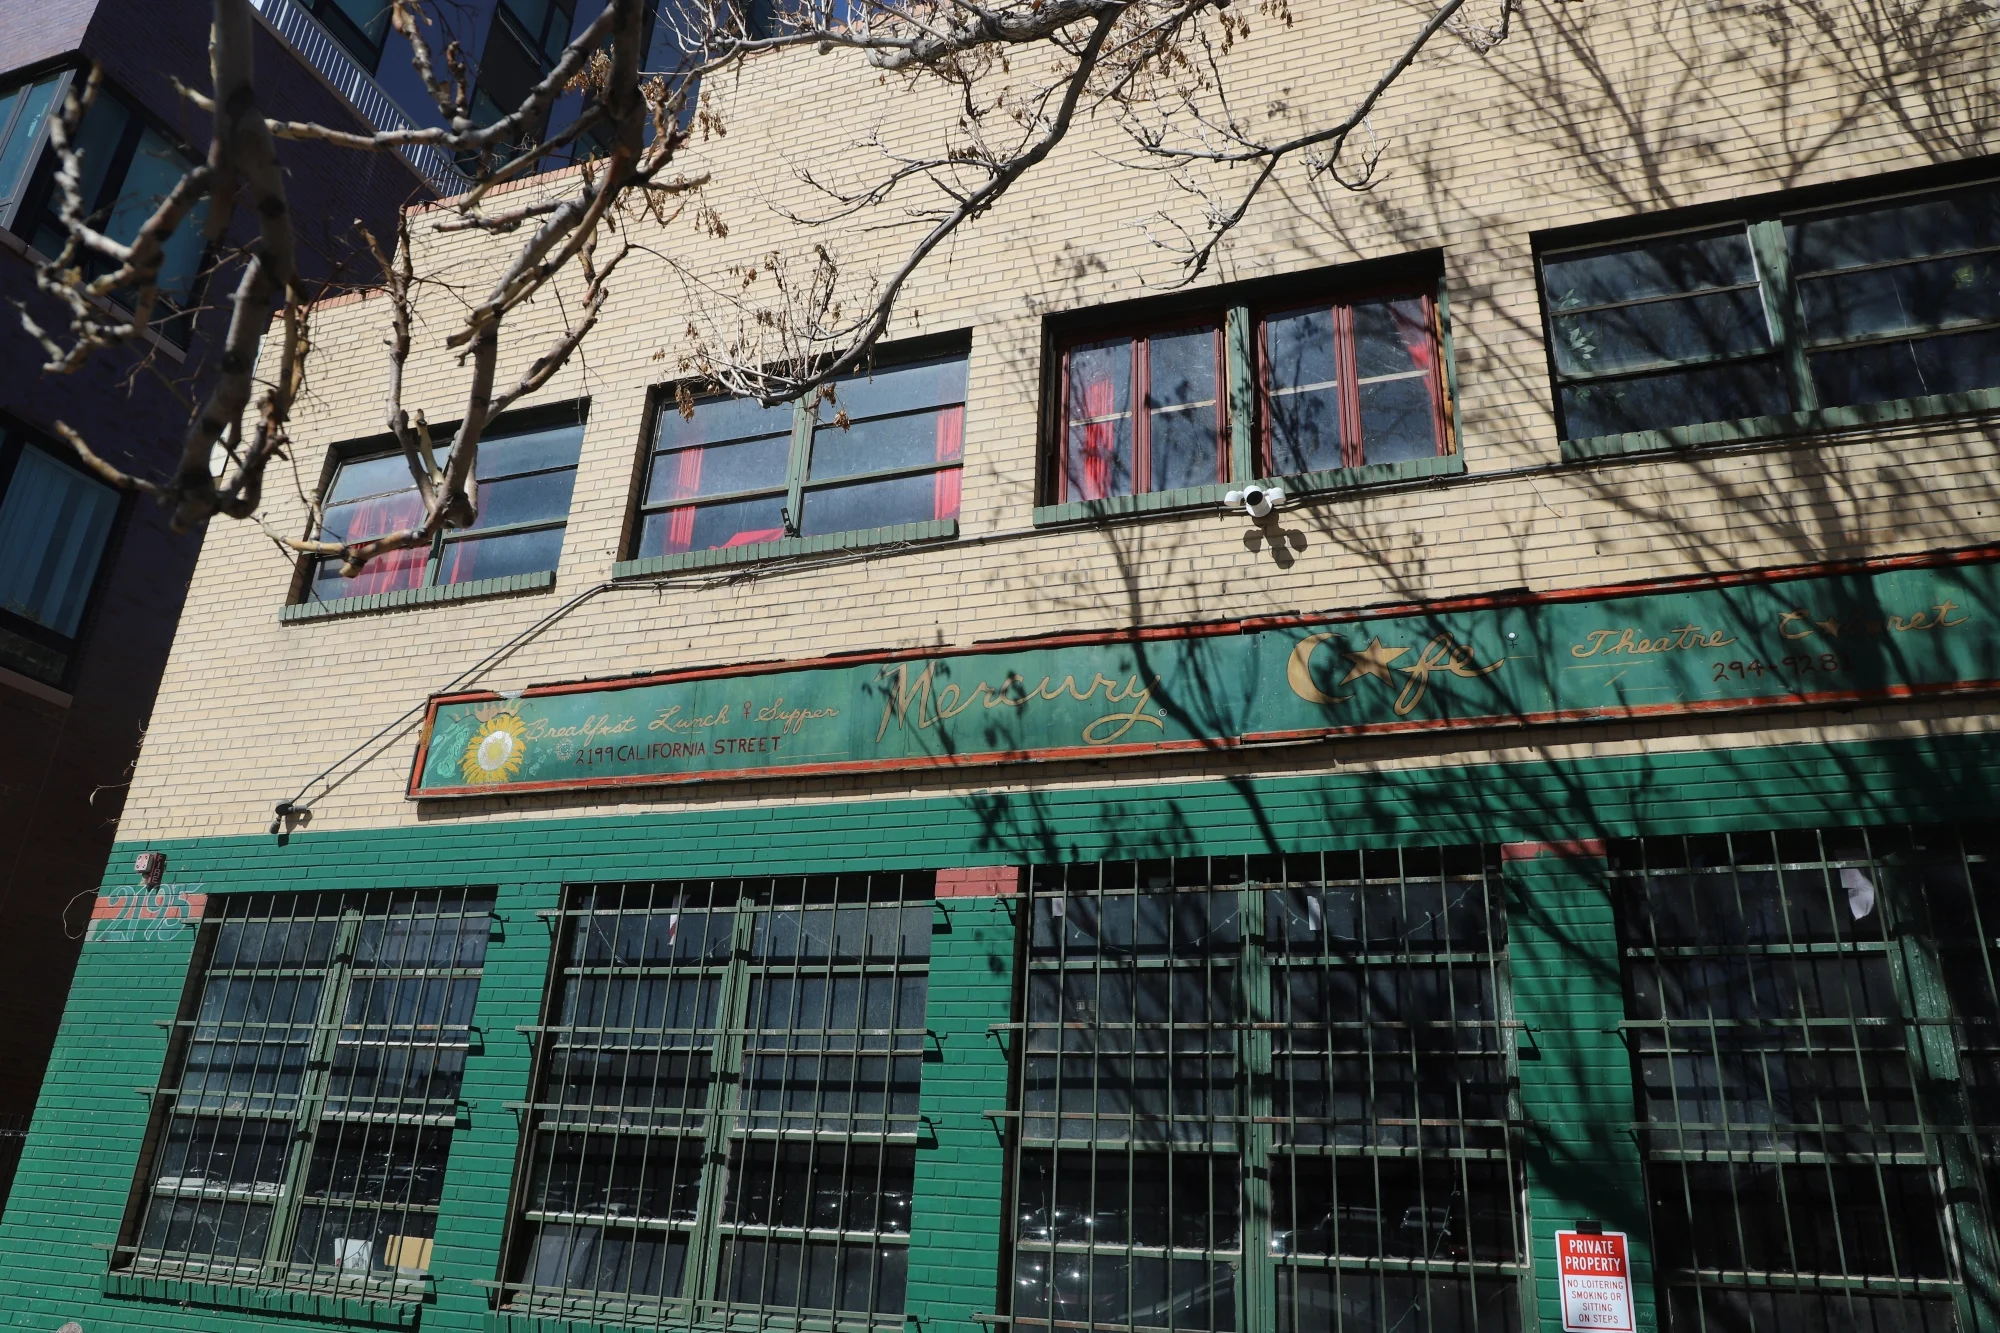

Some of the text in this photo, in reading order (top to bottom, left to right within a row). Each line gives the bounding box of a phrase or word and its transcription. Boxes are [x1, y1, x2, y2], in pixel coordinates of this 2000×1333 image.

[1571, 623, 1739, 659] Theatre
[873, 660, 1165, 745] Mercury
[648, 704, 731, 733] Lunch
[754, 697, 840, 735] Supper
[574, 735, 781, 767] 2199 CALIFORNIA STREET
[151, 855, 164, 884] FIRE
[1569, 1239, 1615, 1255] PRIVATE
[1565, 1256, 1620, 1272] PROPERTY
[1567, 1279, 1624, 1290] NO LOITERING
[1571, 1291, 1622, 1301] SMOKING OR
[1582, 1303, 1613, 1312] SITTING
[1578, 1314, 1619, 1324] ON STEPS
